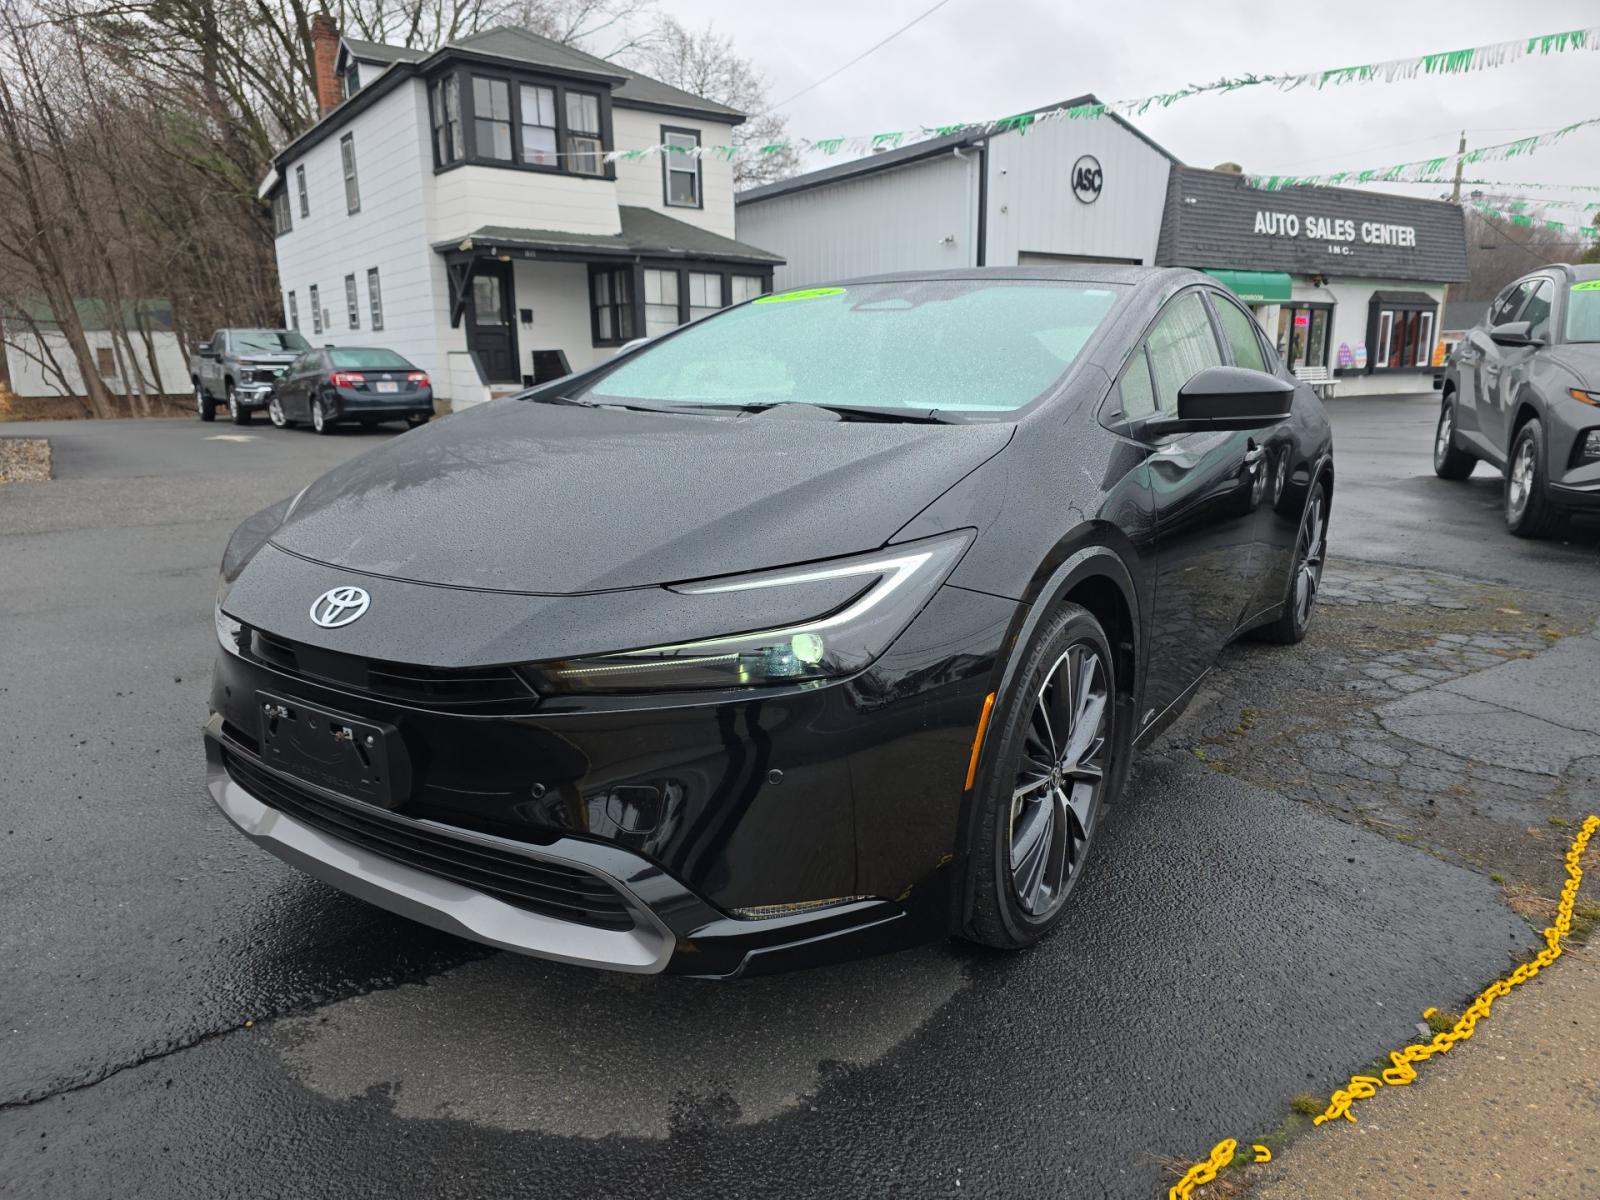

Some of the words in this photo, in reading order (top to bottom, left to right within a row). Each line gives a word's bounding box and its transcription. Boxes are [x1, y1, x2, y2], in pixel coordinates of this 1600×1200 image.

[1074, 167, 1102, 192] ASC
[1254, 211, 1299, 237] AUTO
[1305, 216, 1356, 242] SALES
[1361, 222, 1416, 247] CENTER
[1328, 245, 1354, 255] INC.
